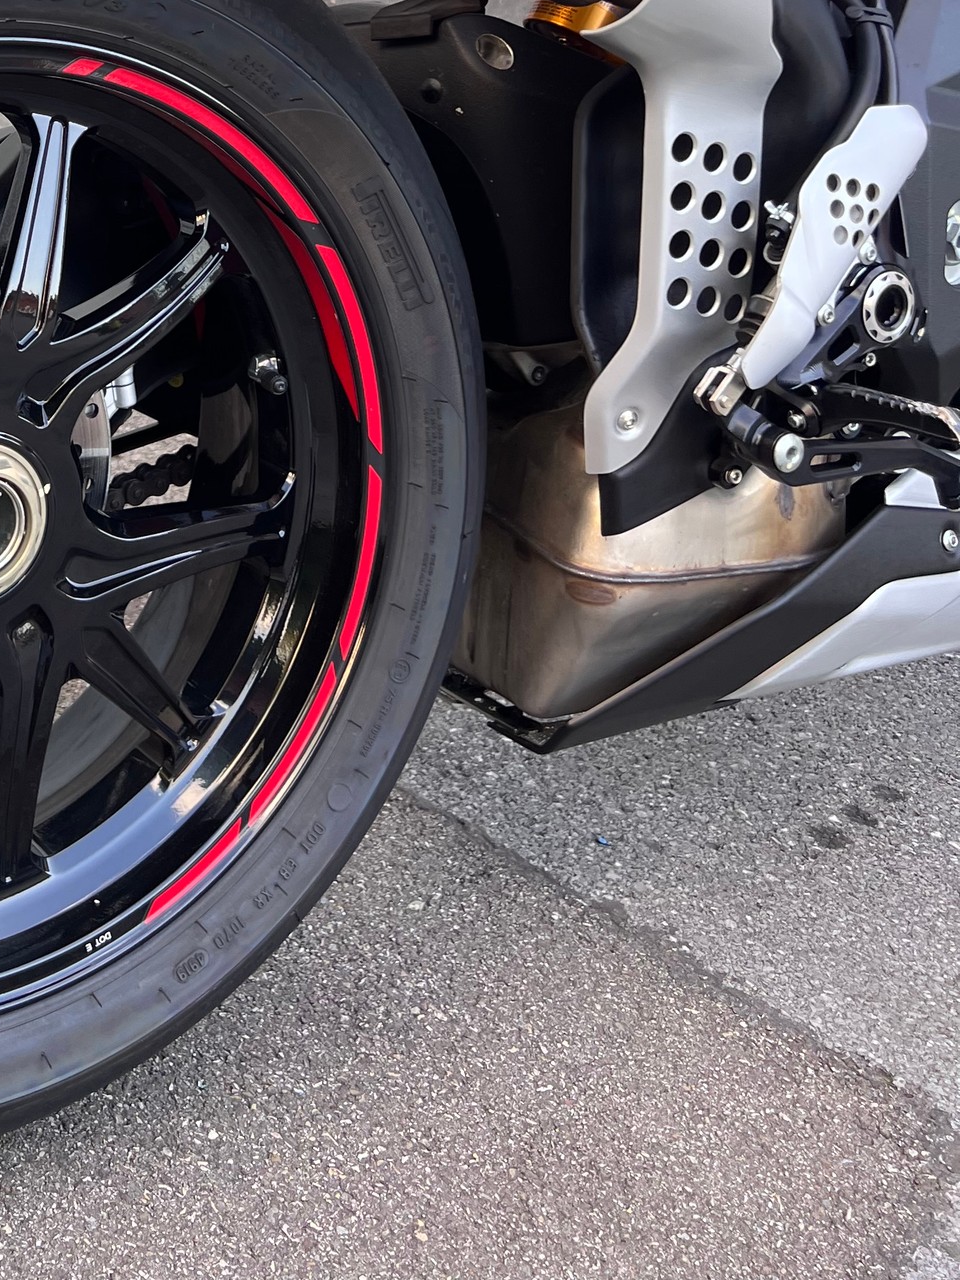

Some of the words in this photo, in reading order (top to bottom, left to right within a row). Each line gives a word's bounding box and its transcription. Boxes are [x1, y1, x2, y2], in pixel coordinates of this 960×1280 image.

[351, 175, 435, 312] PIRELLI
[301, 821, 326, 855] DOT
[85, 942, 93, 953] E
[95, 931, 112, 948] DOT
[177, 952, 207, 982] 4919
